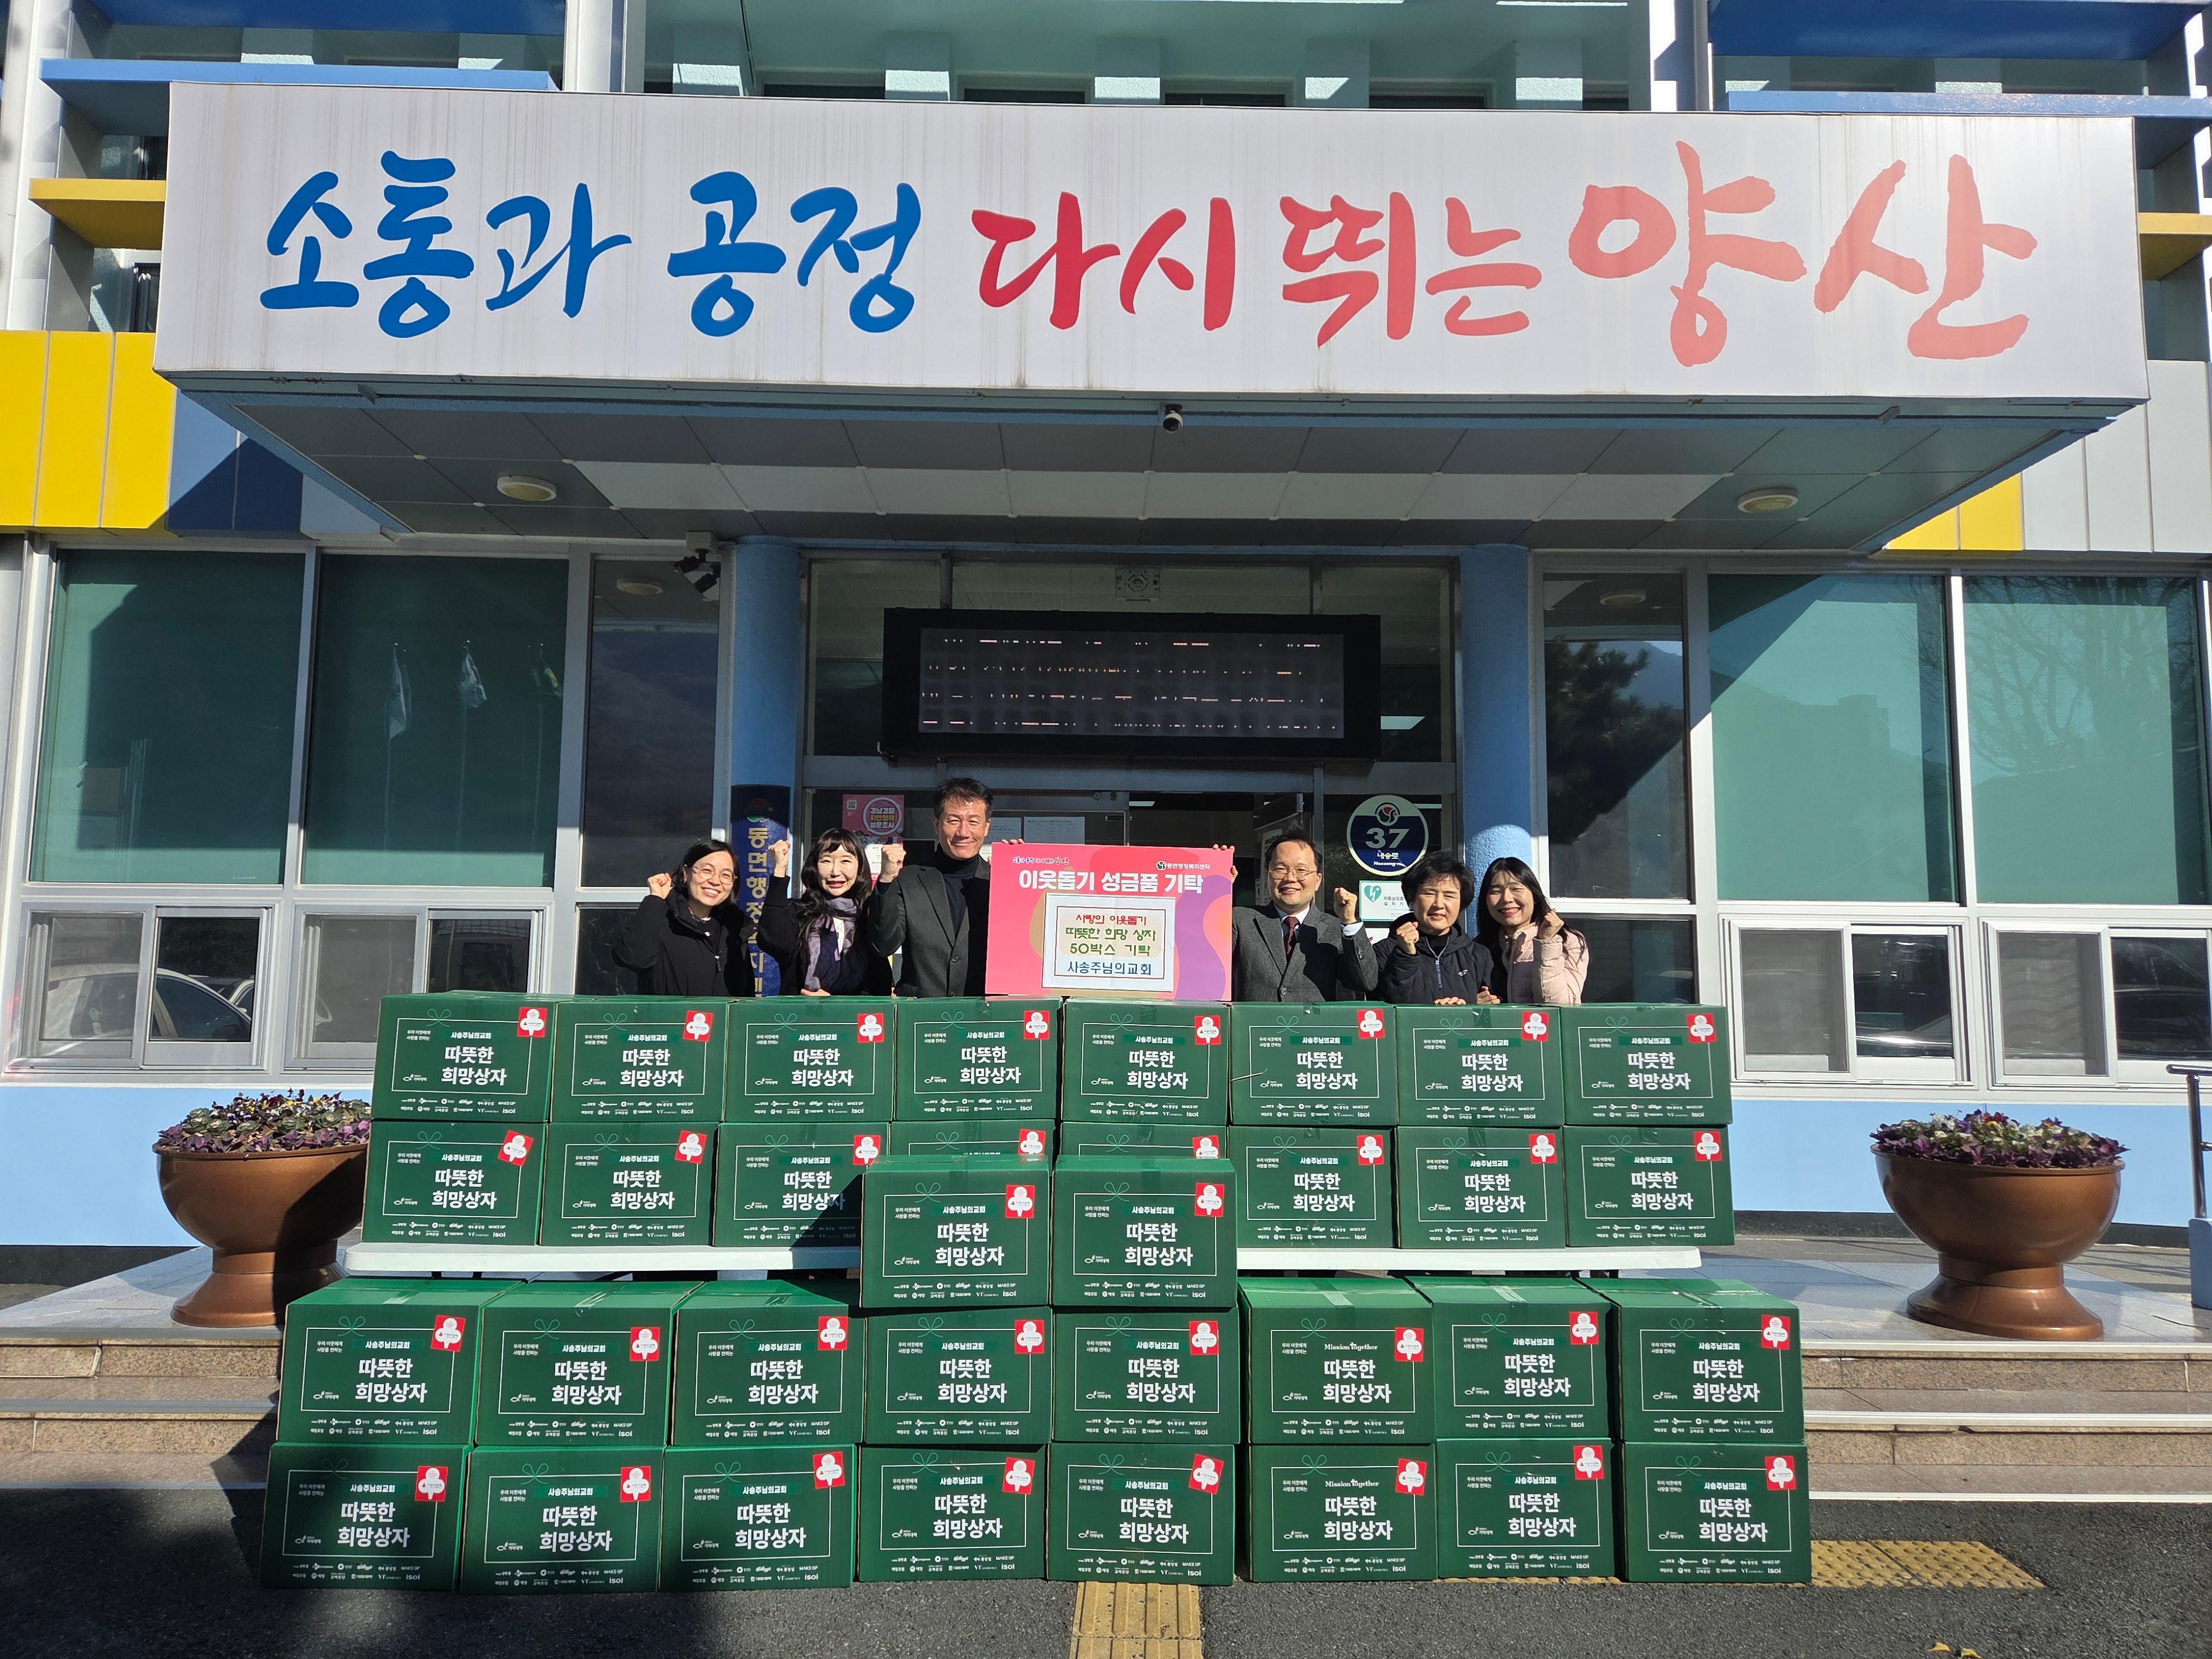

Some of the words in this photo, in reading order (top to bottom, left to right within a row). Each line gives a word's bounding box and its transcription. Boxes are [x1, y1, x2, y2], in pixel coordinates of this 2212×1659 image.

[260, 150, 631, 338] 소통과
[667, 171, 921, 337] 공정
[972, 192, 1235, 330] 다시
[1281, 193, 1540, 346] 뛰는
[1569, 140, 2036, 366] 양산
[1365, 827, 1409, 848] 37
[1018, 869, 1094, 891] 이웃돕기
[1100, 872, 1158, 893] 성금품
[1165, 874, 1203, 893] 기탁
[746, 827, 768, 997] 동면행정지
[1075, 914, 1104, 924] 사랑의
[1109, 916, 1146, 925] 이웃돕기
[1065, 927, 1099, 940] 따뜻한
[1105, 928, 1128, 940] 희망
[1133, 929, 1156, 941] 상자
[1070, 943, 1115, 956] 50박스
[1125, 944, 1150, 956] 기탁
[1067, 961, 1151, 975] 사송주님의교회
[445, 1046, 494, 1063] 따뜻한
[623, 1049, 670, 1066] 따뜻한
[794, 1048, 840, 1065] 따뜻한
[962, 1046, 1007, 1063] 따뜻한
[1129, 1050, 1175, 1067] 따뜻한
[1297, 1052, 1343, 1068] 따뜻한
[1462, 1054, 1508, 1070] 따뜻한
[1628, 1052, 1675, 1068] 따뜻한
[441, 1067, 508, 1086] 희망상자
[620, 1070, 684, 1087] 희망상자
[791, 1070, 854, 1087] 희망상자
[960, 1067, 1021, 1084] 희망상자
[1127, 1071, 1188, 1089] 희망상자
[1296, 1073, 1358, 1089] 희망상자
[1462, 1074, 1523, 1092] 희망상자
[1628, 1073, 1691, 1090] 희망상자
[435, 1169, 484, 1187] 따뜻한
[613, 1170, 661, 1187] 따뜻한
[784, 1171, 832, 1189] 따뜻한
[1295, 1173, 1340, 1190] 따뜻한
[1465, 1174, 1511, 1191] 따뜻한
[1631, 1172, 1678, 1188] 따뜻한
[432, 1191, 497, 1209] 희망상자
[611, 1192, 675, 1209] 희망상자
[782, 1193, 845, 1211] 희망상자
[1293, 1194, 1355, 1212] 희망상자
[1464, 1196, 1526, 1213] 희망상자
[1631, 1193, 1693, 1210] 희망상자
[937, 1223, 989, 1242] 따뜻한
[1127, 1223, 1178, 1241] 따뜻한
[935, 1246, 1004, 1266] 희망상자
[1125, 1247, 1193, 1266] 희망상자
[1136, 1341, 1178, 1349] 사송주님의교회
[1512, 1338, 1555, 1346] 사송주님의교회
[359, 1358, 413, 1378] 따뜻한
[555, 1361, 607, 1380] 따뜻한
[751, 1360, 803, 1380] 따뜻한
[940, 1359, 992, 1378] 따뜻한
[1129, 1358, 1180, 1378] 따뜻한
[1324, 1359, 1375, 1379] 따뜻한
[1505, 1354, 1555, 1373] 따뜻한
[1693, 1359, 1744, 1378] 따뜻한
[356, 1383, 427, 1403] 희망상자
[552, 1385, 622, 1405] 희망상자
[748, 1384, 818, 1405] 희망상자
[938, 1383, 1007, 1403] 희망상자
[1126, 1383, 1196, 1403] 희망상자
[1323, 1384, 1391, 1403] 희망상자
[1504, 1378, 1571, 1397] 희망상자
[1693, 1383, 1760, 1402] 희망상자
[350, 1484, 395, 1493] 사송주님의교회
[940, 1476, 983, 1485] 사송주님의교회
[1125, 1481, 1168, 1490] 사송주님의교회
[1515, 1476, 1556, 1484] 사송주님의교회
[548, 1488, 593, 1496] 사송주님의교회
[743, 1485, 786, 1494] 사송주님의교회
[935, 1494, 987, 1514] 따뜻한
[1121, 1498, 1173, 1518] 따뜻한
[1326, 1496, 1376, 1516] 따뜻한
[1509, 1493, 1560, 1512] 따뜻한
[1700, 1498, 1751, 1517] 따뜻한
[341, 1502, 395, 1522] 따뜻한
[543, 1505, 597, 1527] 따뜻한
[737, 1503, 791, 1524] 따뜻한
[933, 1518, 1003, 1539] 희망상자
[1119, 1522, 1189, 1543] 희망상자
[1324, 1520, 1392, 1540] 희망상자
[1509, 1517, 1576, 1537] 희망상자
[1699, 1522, 1768, 1542] 희망상자
[338, 1527, 410, 1547] 희망상자
[540, 1530, 612, 1552] 희망상자
[735, 1527, 806, 1550] 희망상자
